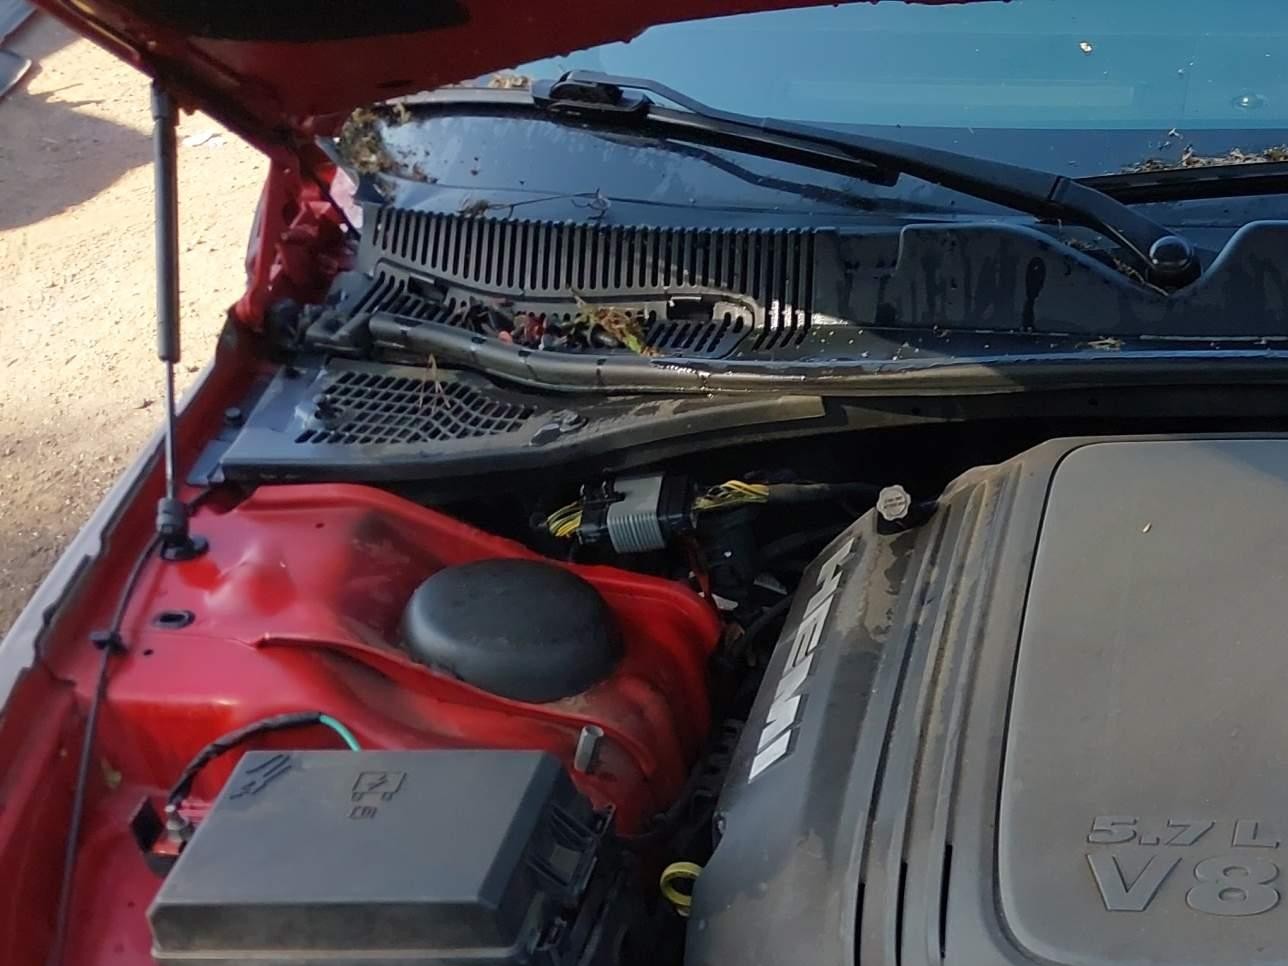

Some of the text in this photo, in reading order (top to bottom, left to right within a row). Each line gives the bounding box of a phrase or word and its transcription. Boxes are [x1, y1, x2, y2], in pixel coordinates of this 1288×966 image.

[748, 536, 855, 784] HEMI
[1086, 815, 1281, 849] 5.7 L
[1084, 853, 1281, 918] V8
